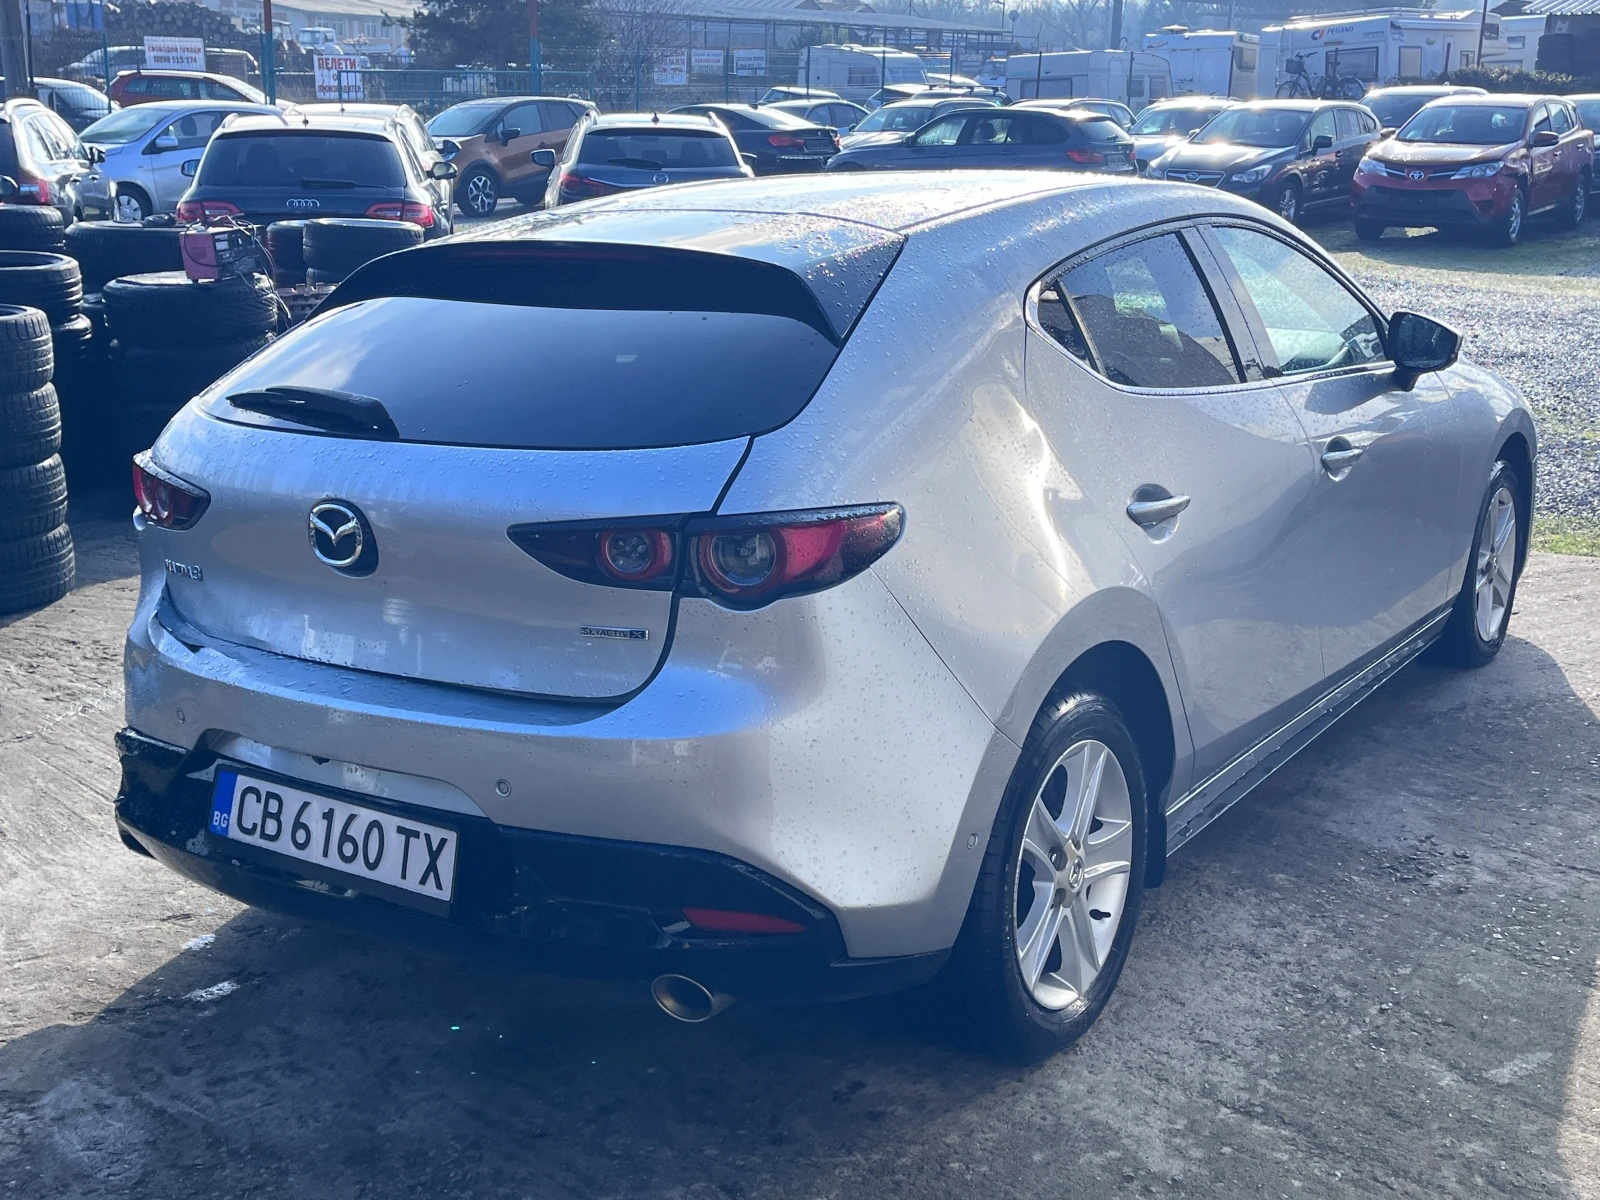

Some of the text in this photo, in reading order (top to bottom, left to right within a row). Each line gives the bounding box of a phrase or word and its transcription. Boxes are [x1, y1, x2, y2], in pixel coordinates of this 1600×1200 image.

[1326, 26, 1355, 36] PEGASO
[317, 57, 357, 70] ПЕЛЕТИ
[582, 626, 630, 639] SKYACTIV
[212, 810, 230, 828] BG
